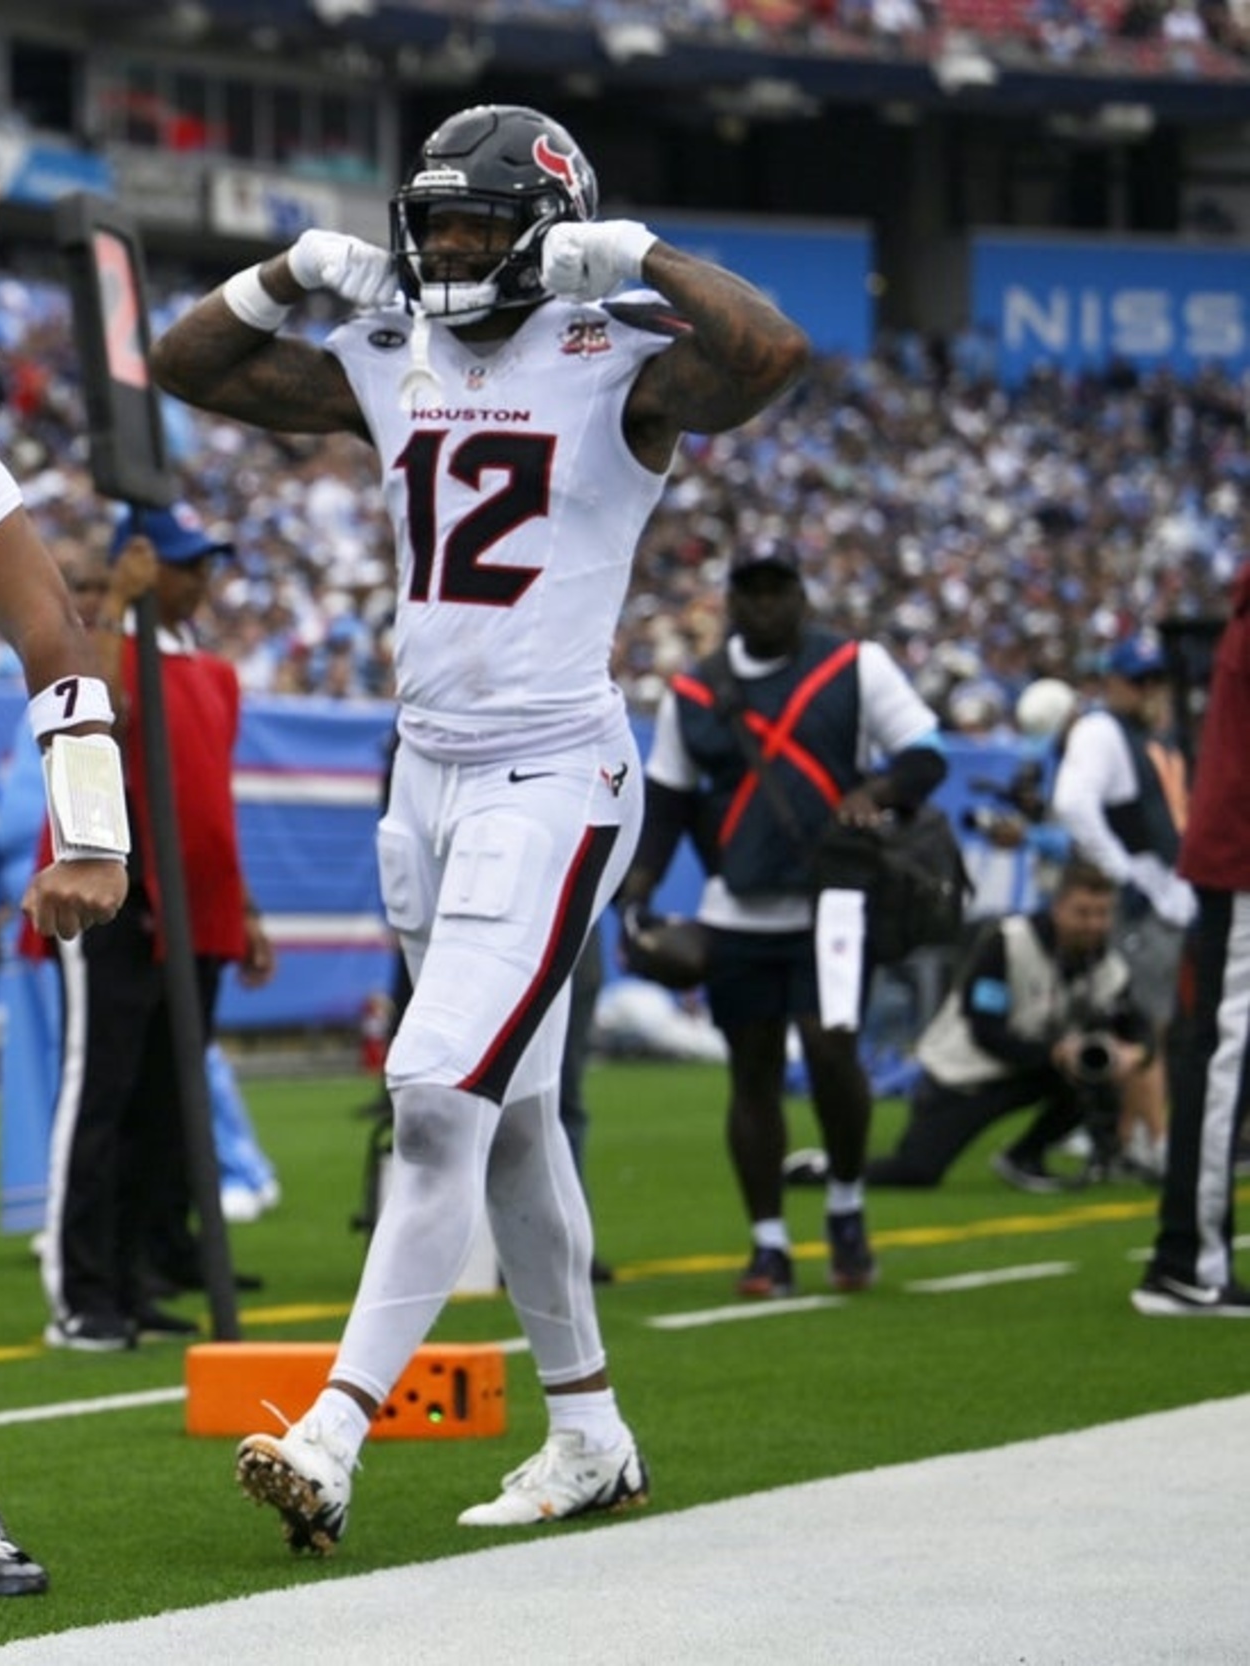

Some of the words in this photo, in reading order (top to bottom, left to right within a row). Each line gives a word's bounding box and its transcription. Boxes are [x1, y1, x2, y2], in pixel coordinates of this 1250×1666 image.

[411, 409, 531, 422] HOUSTON
[392, 429, 557, 608] 12
[55, 677, 79, 719] 7
